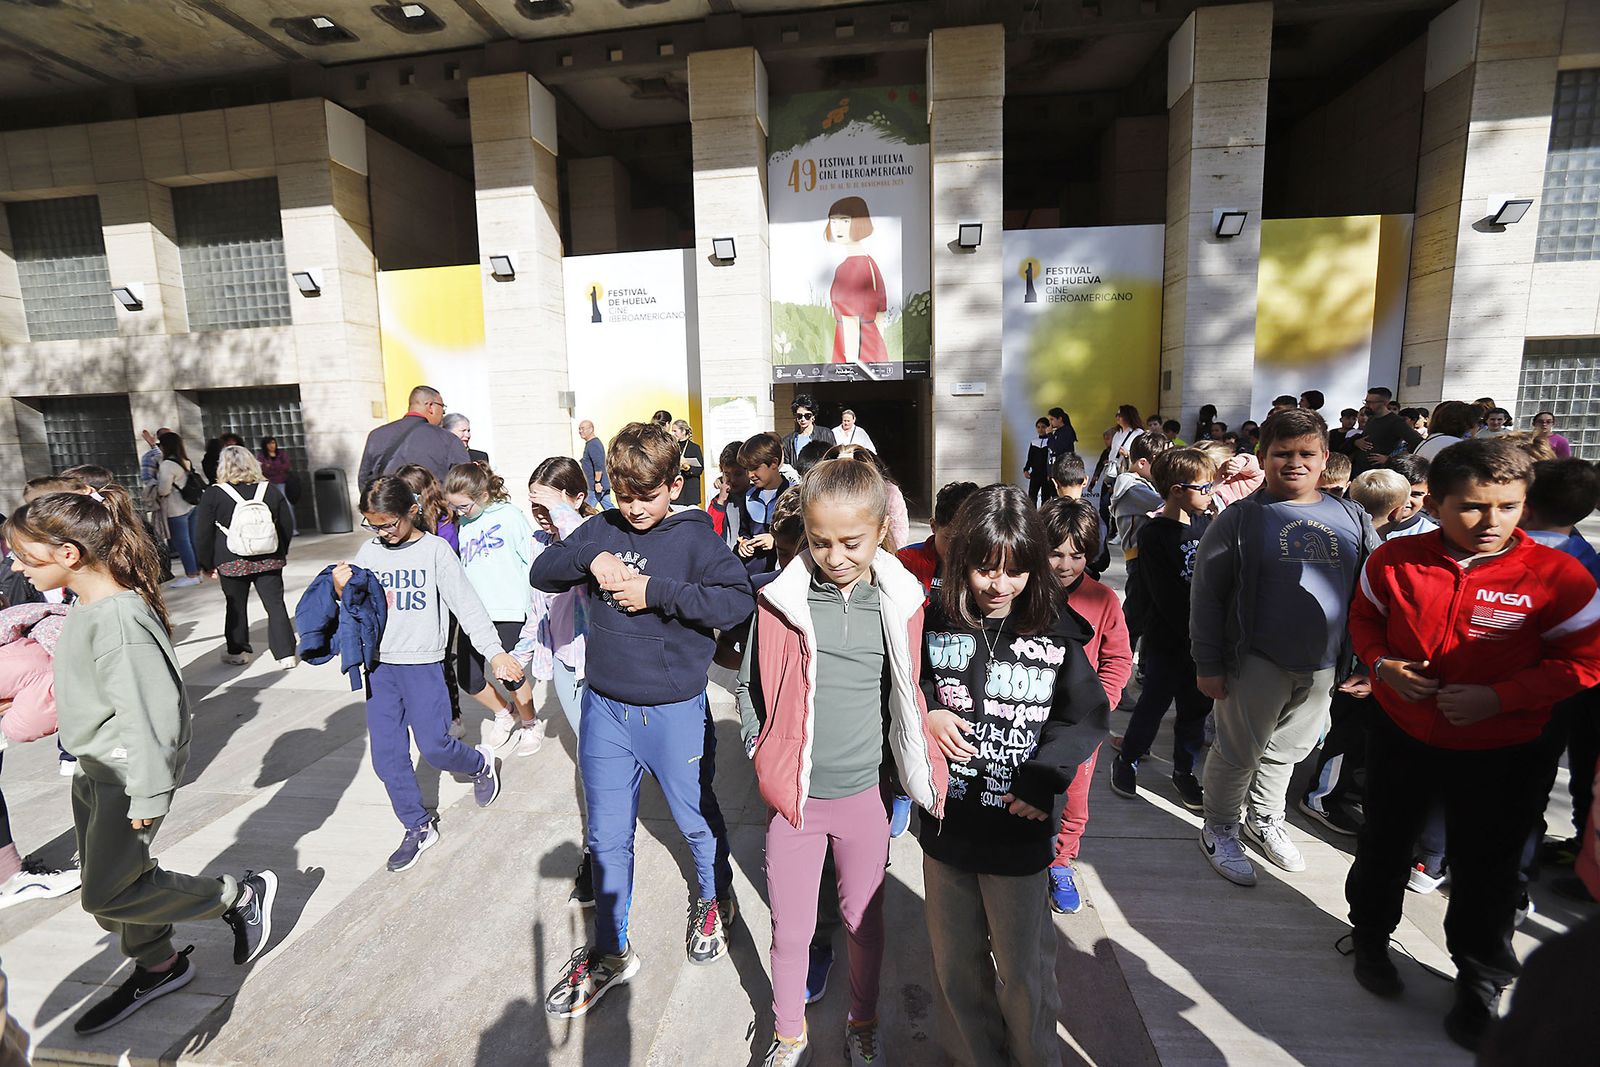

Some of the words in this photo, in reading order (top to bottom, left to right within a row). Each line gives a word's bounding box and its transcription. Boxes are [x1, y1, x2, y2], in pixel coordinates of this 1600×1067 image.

[819, 156, 855, 168] FESTIVAL
[859, 155, 869, 166] DE
[872, 153, 904, 165] HUELVA
[788, 159, 817, 193] 49
[819, 169, 838, 180] CINE
[841, 165, 914, 179] IBEROAMERICANO
[1046, 266, 1092, 276] FESTIVAL
[1046, 277, 1059, 285] DE
[1062, 275, 1102, 285] HUELVA
[608, 288, 648, 297] FESTIVAL
[1046, 286, 1068, 294] CINE
[608, 298, 620, 306] DE
[622, 296, 656, 305] HUELVA
[1046, 292, 1133, 303] IBEROAMERICANO
[608, 311, 686, 323] IBEROAMERICANO
[1280, 519, 1303, 537] SUNNY
[1307, 519, 1335, 537] BEACH
[1330, 536, 1339, 557] DAYS
[374, 569, 426, 589] aBU
[1476, 588, 1533, 609] NASA
